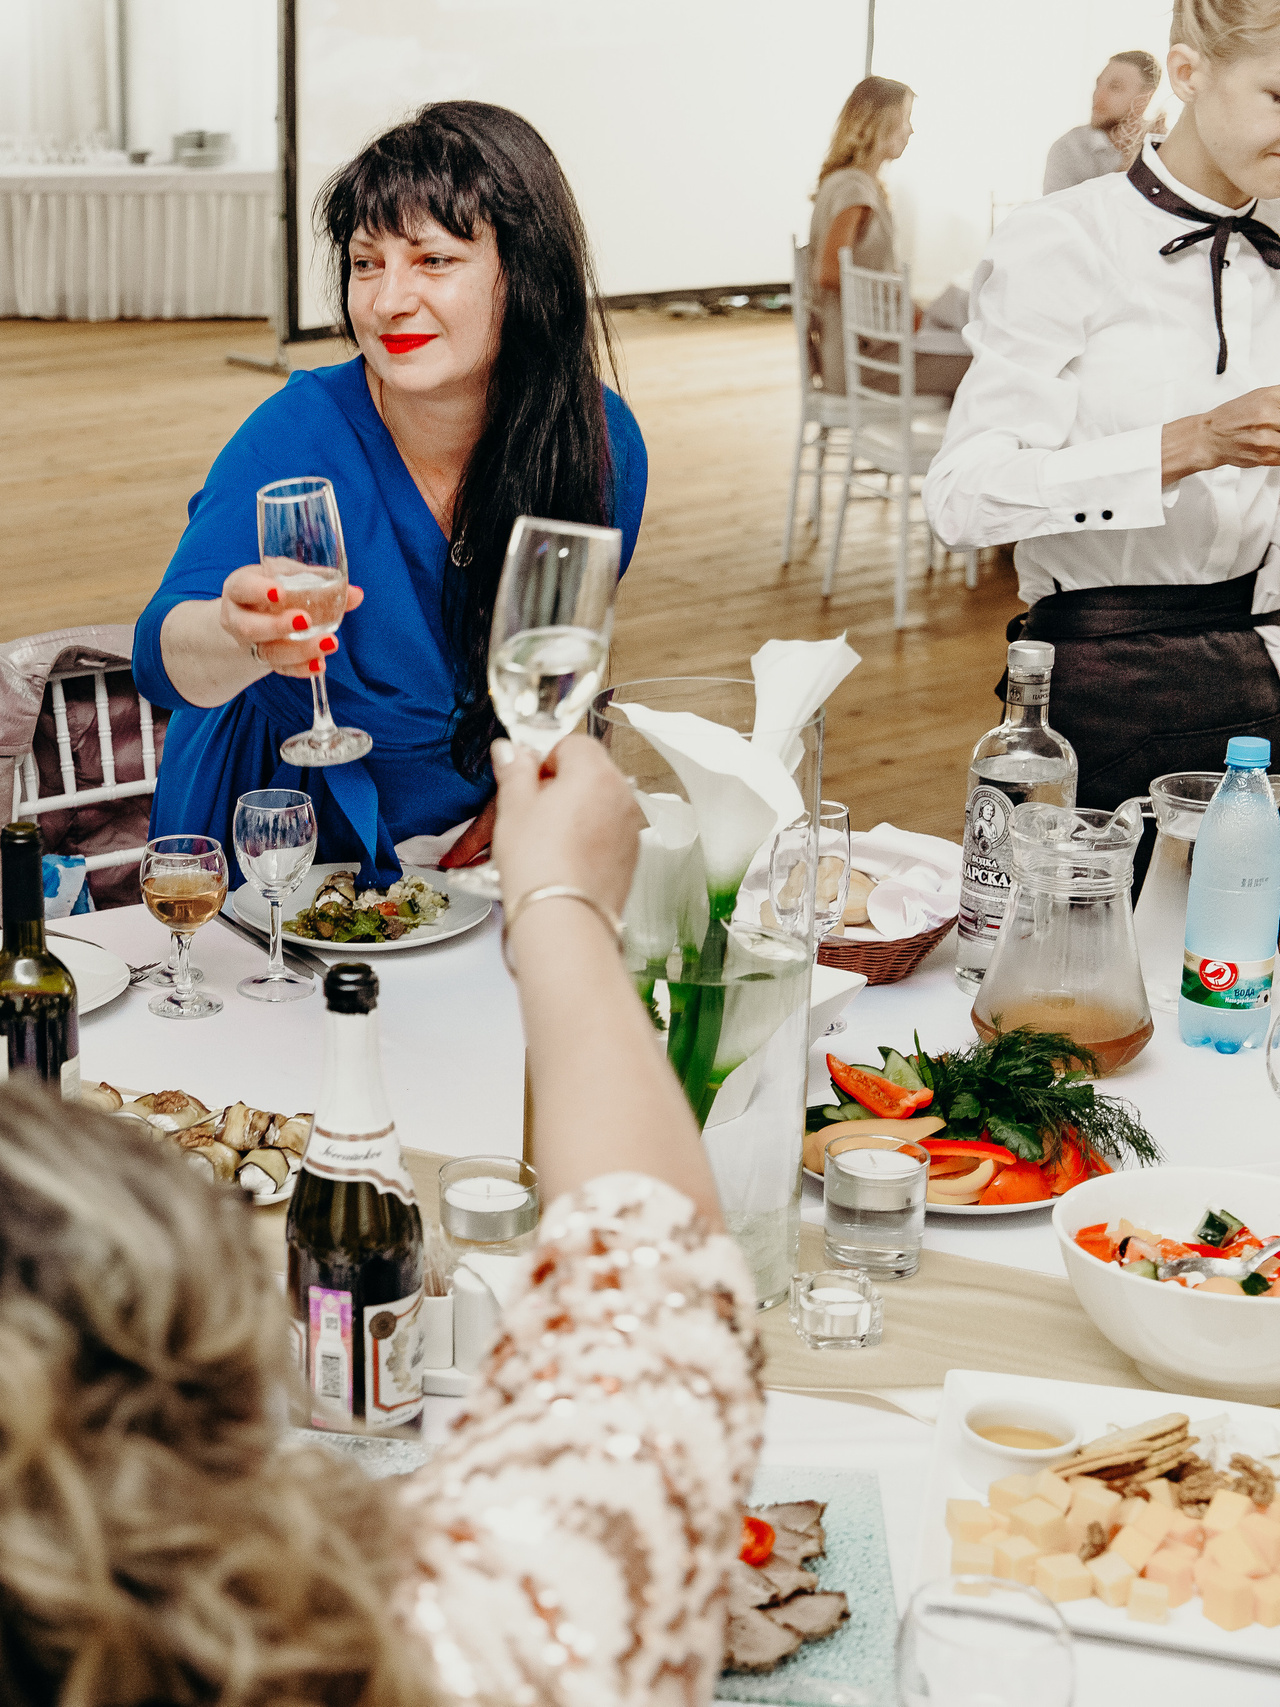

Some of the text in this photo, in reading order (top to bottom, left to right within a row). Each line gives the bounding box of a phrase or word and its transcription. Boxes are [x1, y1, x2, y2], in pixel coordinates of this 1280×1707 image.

[971, 854, 999, 869] ВОДКА
[963, 861, 1010, 888] АРСКА
[1234, 988, 1255, 998] ВОДА
